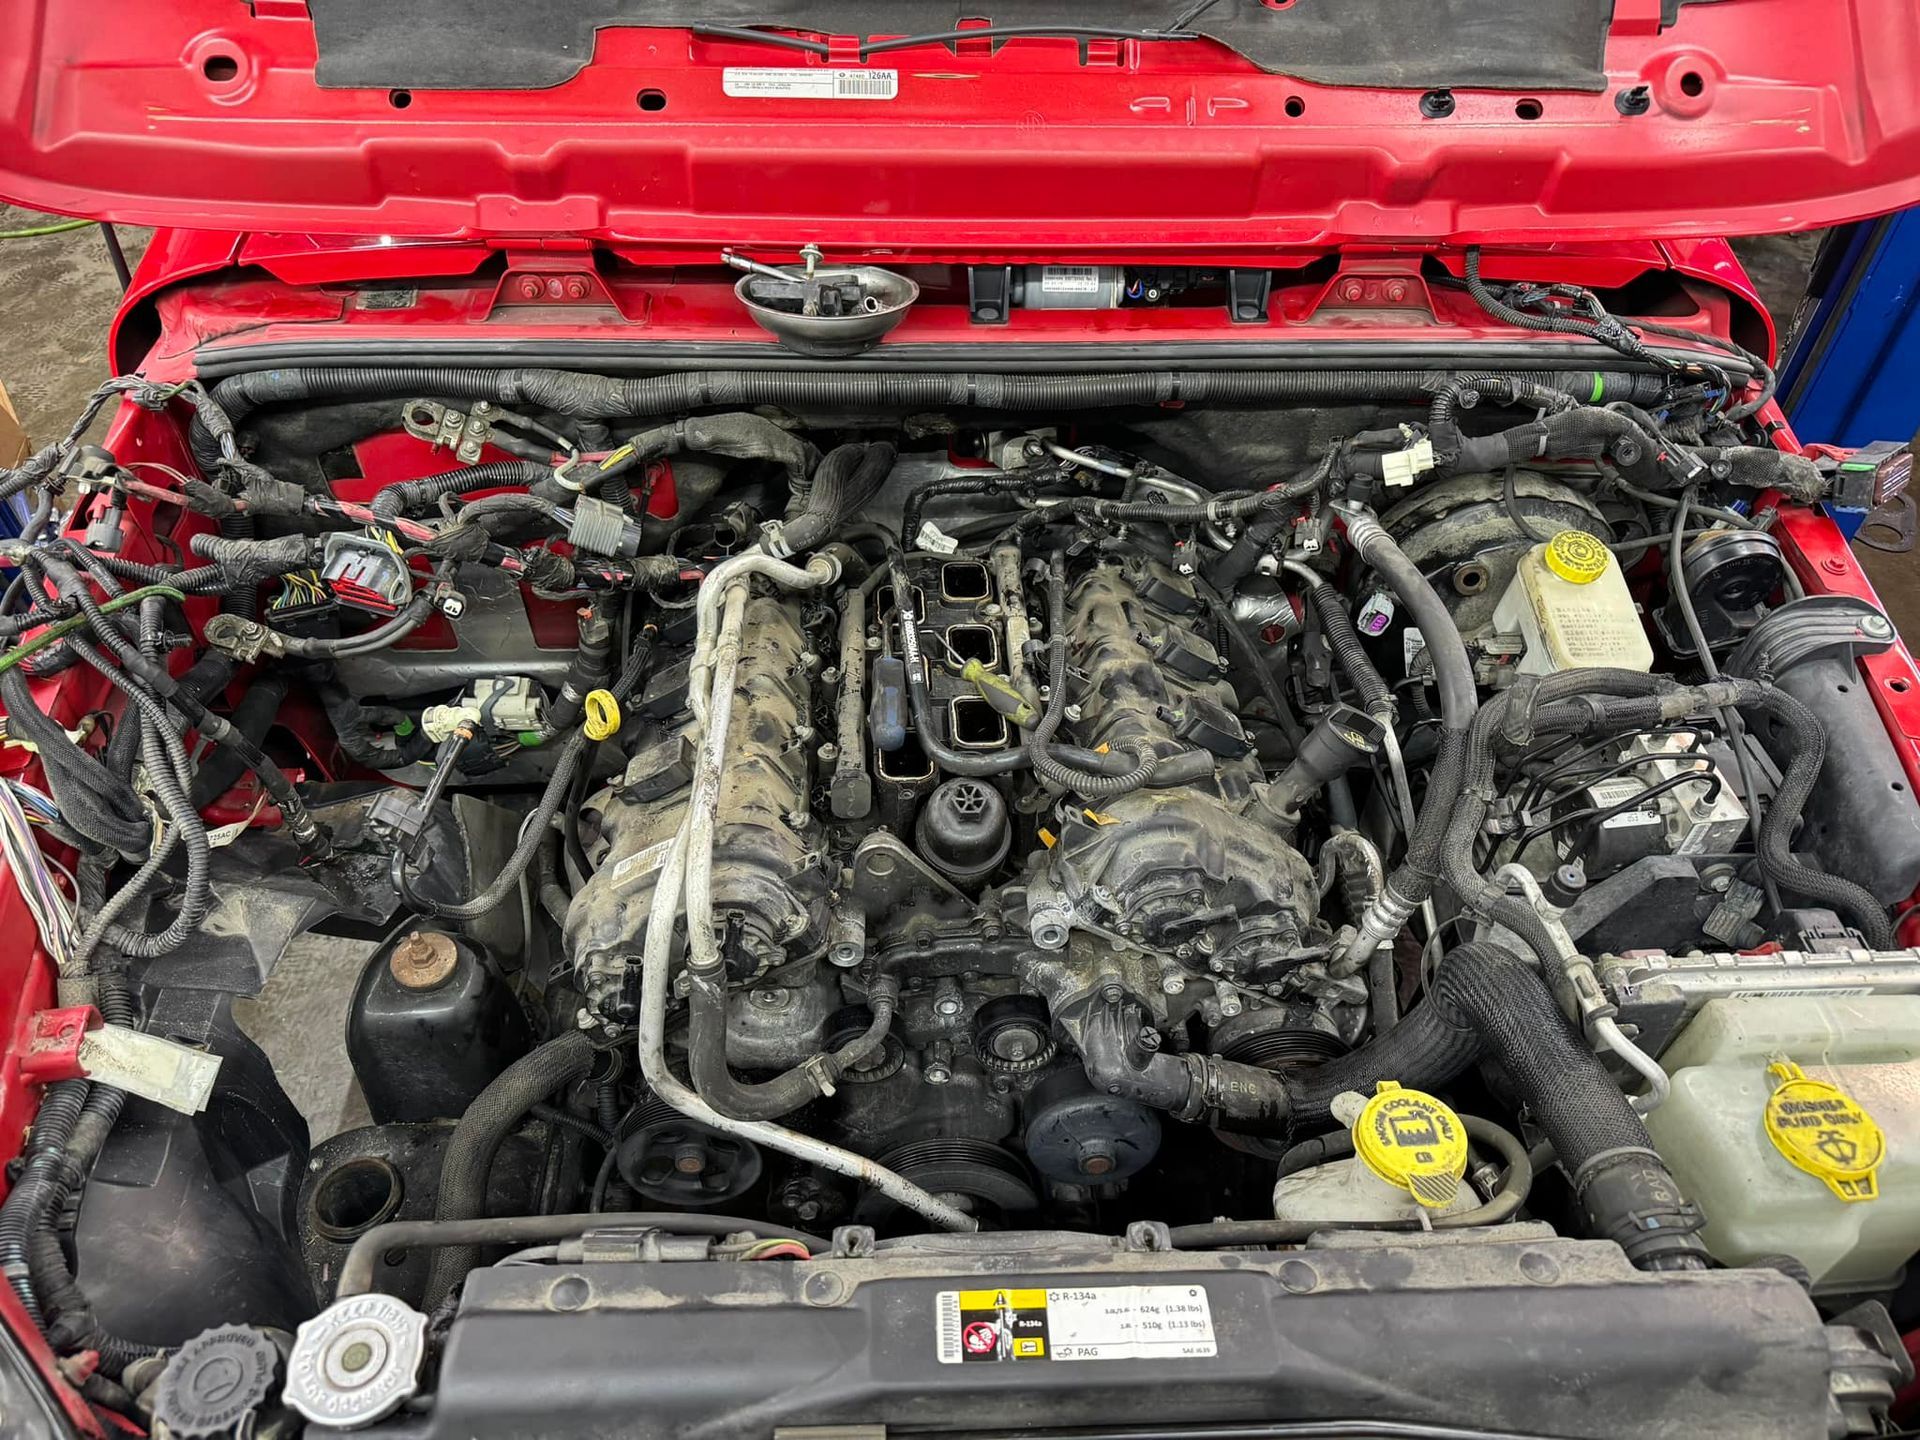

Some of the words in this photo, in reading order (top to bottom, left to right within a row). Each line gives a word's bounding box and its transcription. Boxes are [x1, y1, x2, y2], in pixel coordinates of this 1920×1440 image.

[869, 70, 892, 79] 126AA
[1230, 1081, 1257, 1095] ENG
[1383, 1099, 1438, 1115] COOLANT
[1062, 1291, 1097, 1300] R-134a
[1140, 1306, 1160, 1315] 624g
[1142, 1321, 1162, 1331] 510g
[1078, 1347, 1098, 1357] PAG
